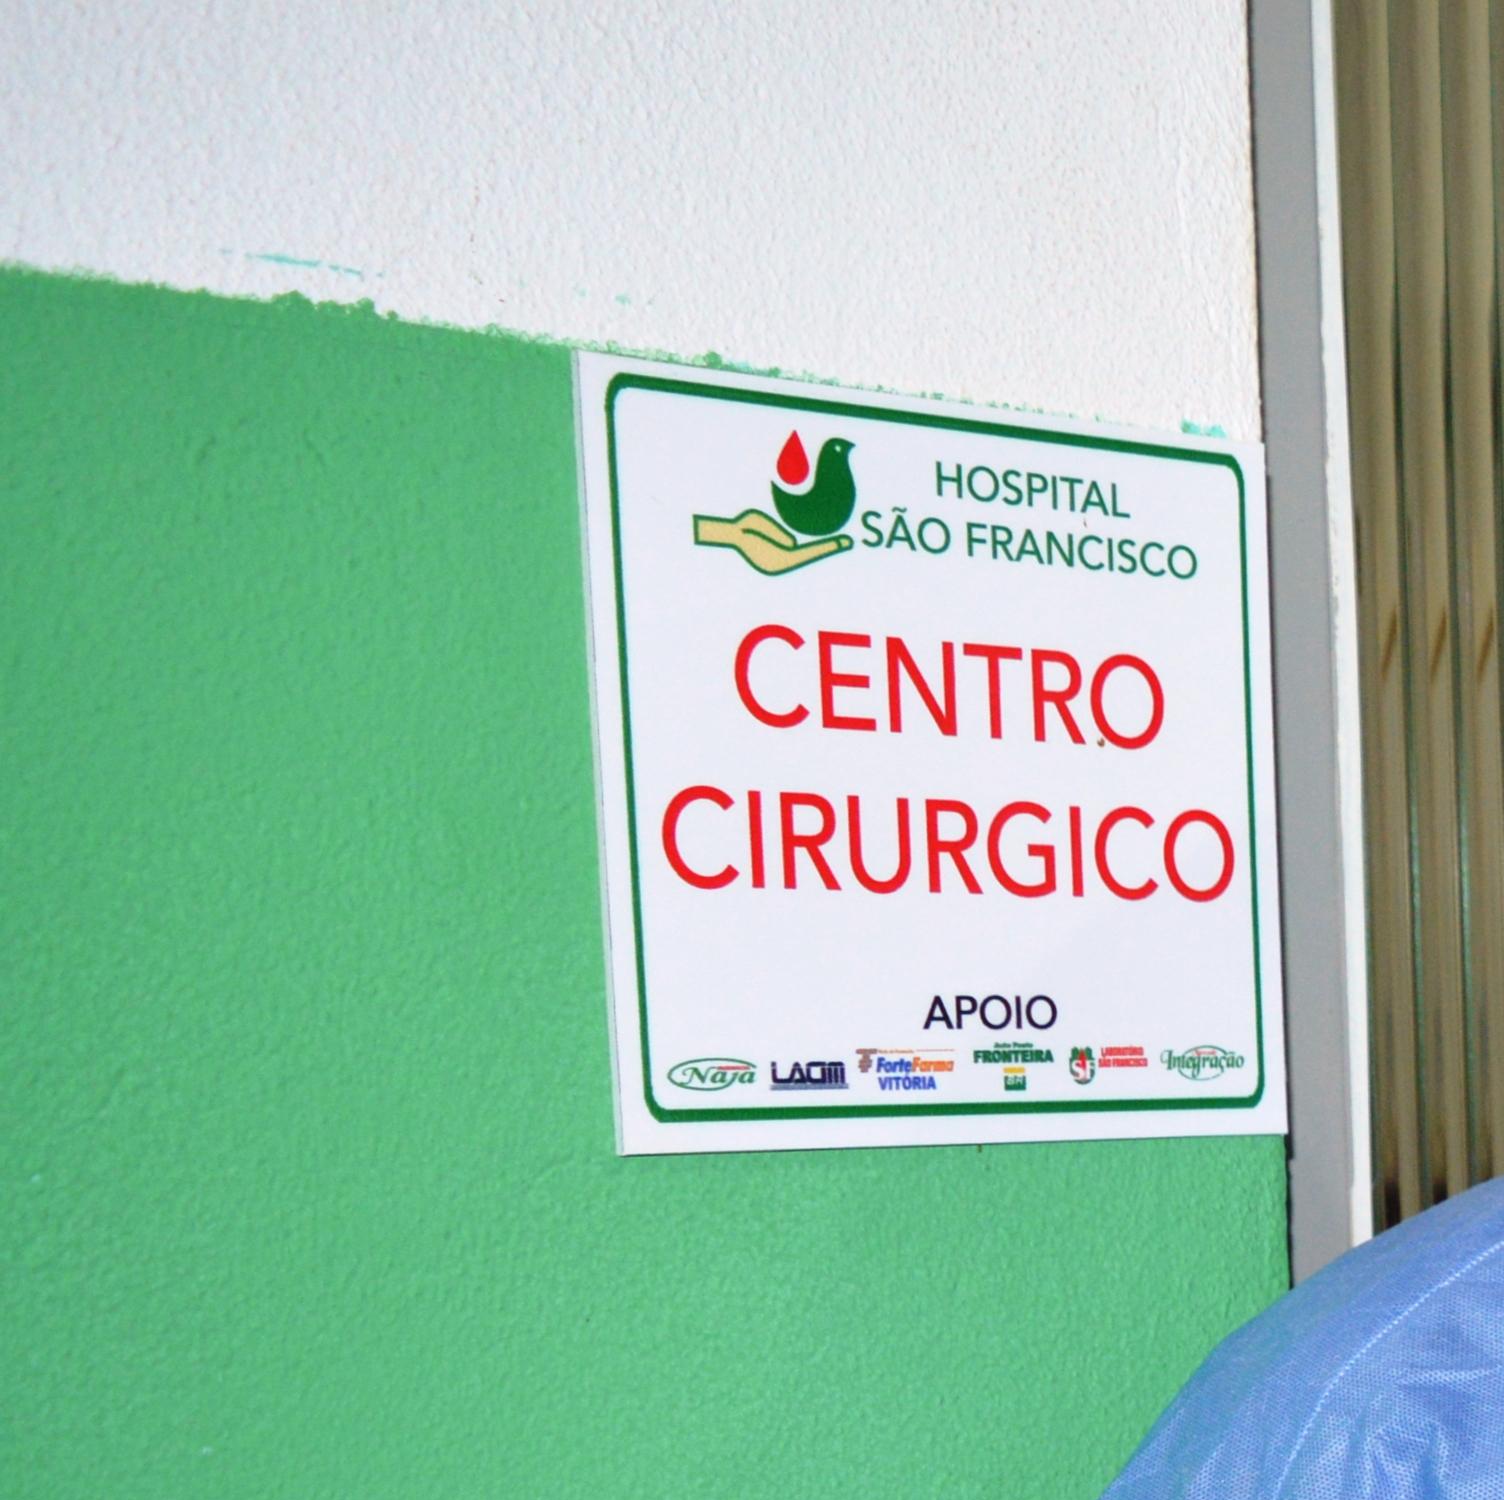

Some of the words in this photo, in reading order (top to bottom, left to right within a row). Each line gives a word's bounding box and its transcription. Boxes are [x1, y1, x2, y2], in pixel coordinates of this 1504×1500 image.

[935, 460, 1131, 518] HOSPITAL
[861, 506, 952, 554] SÃO
[966, 521, 1198, 580] FRANCISCO
[733, 624, 1165, 750] CENTRO
[661, 785, 1236, 903] CIRURGICO
[923, 994, 1058, 1030] APOIO
[973, 1050, 1054, 1063] FRONTEIRA
